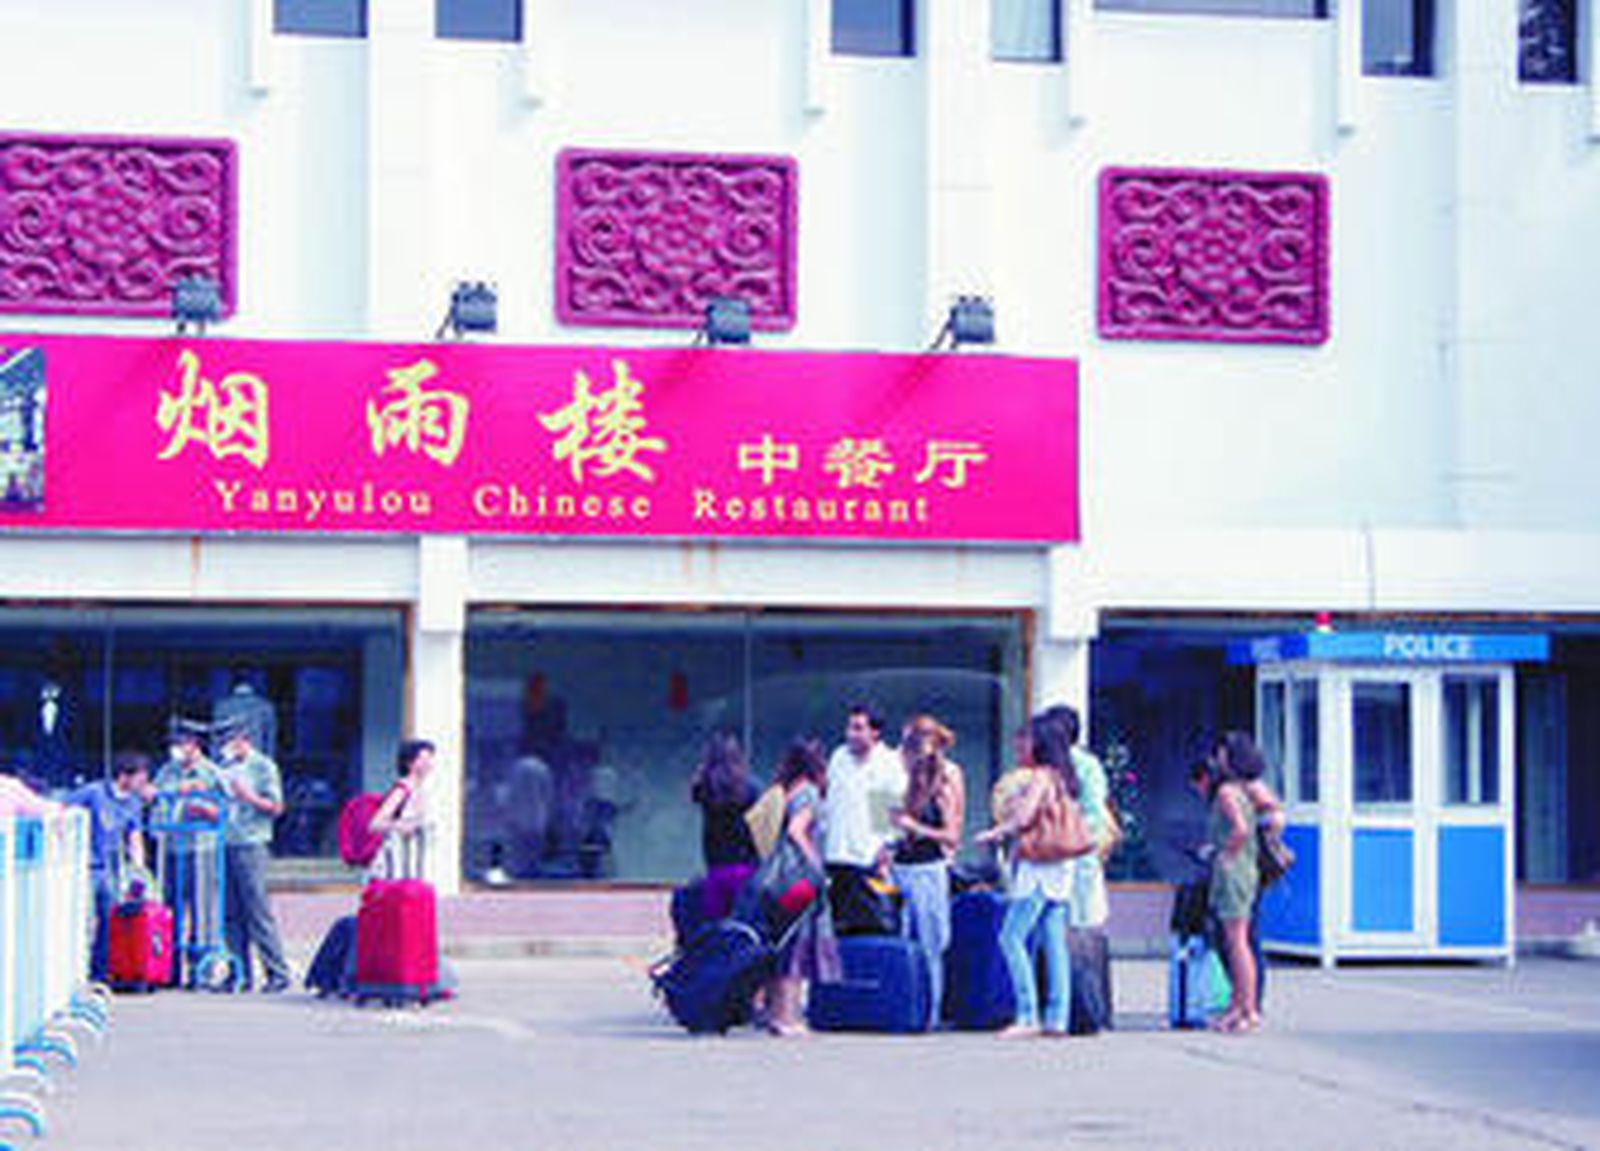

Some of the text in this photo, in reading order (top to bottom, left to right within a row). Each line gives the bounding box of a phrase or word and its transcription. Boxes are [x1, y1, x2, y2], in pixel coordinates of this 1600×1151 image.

[156, 349, 989, 488] 烟雨楼 中餐厅
[214, 480, 929, 524] Yanyulou Chinese Restaurant
[1383, 633, 1474, 659] POLICE
